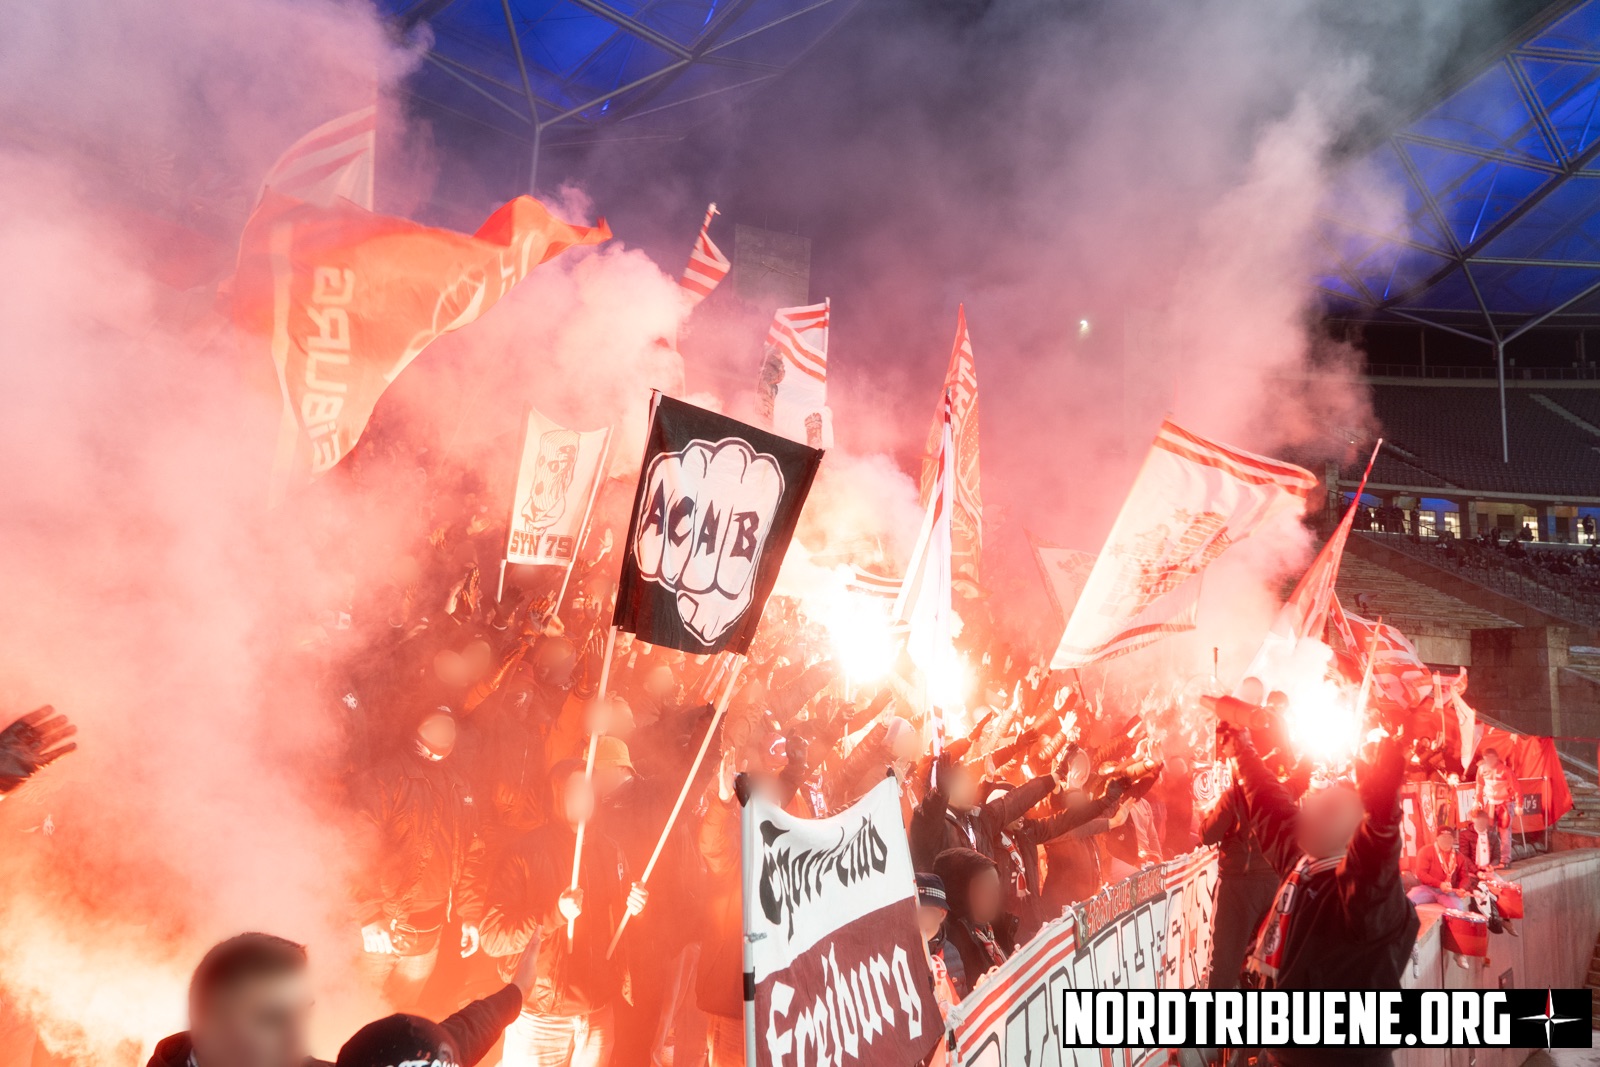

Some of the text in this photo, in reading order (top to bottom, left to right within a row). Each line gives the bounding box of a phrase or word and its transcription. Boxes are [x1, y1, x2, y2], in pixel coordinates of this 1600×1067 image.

[510, 530, 574, 559] SYN 79
[641, 478, 760, 564] ACAB
[765, 942, 922, 1067] Freiburg
